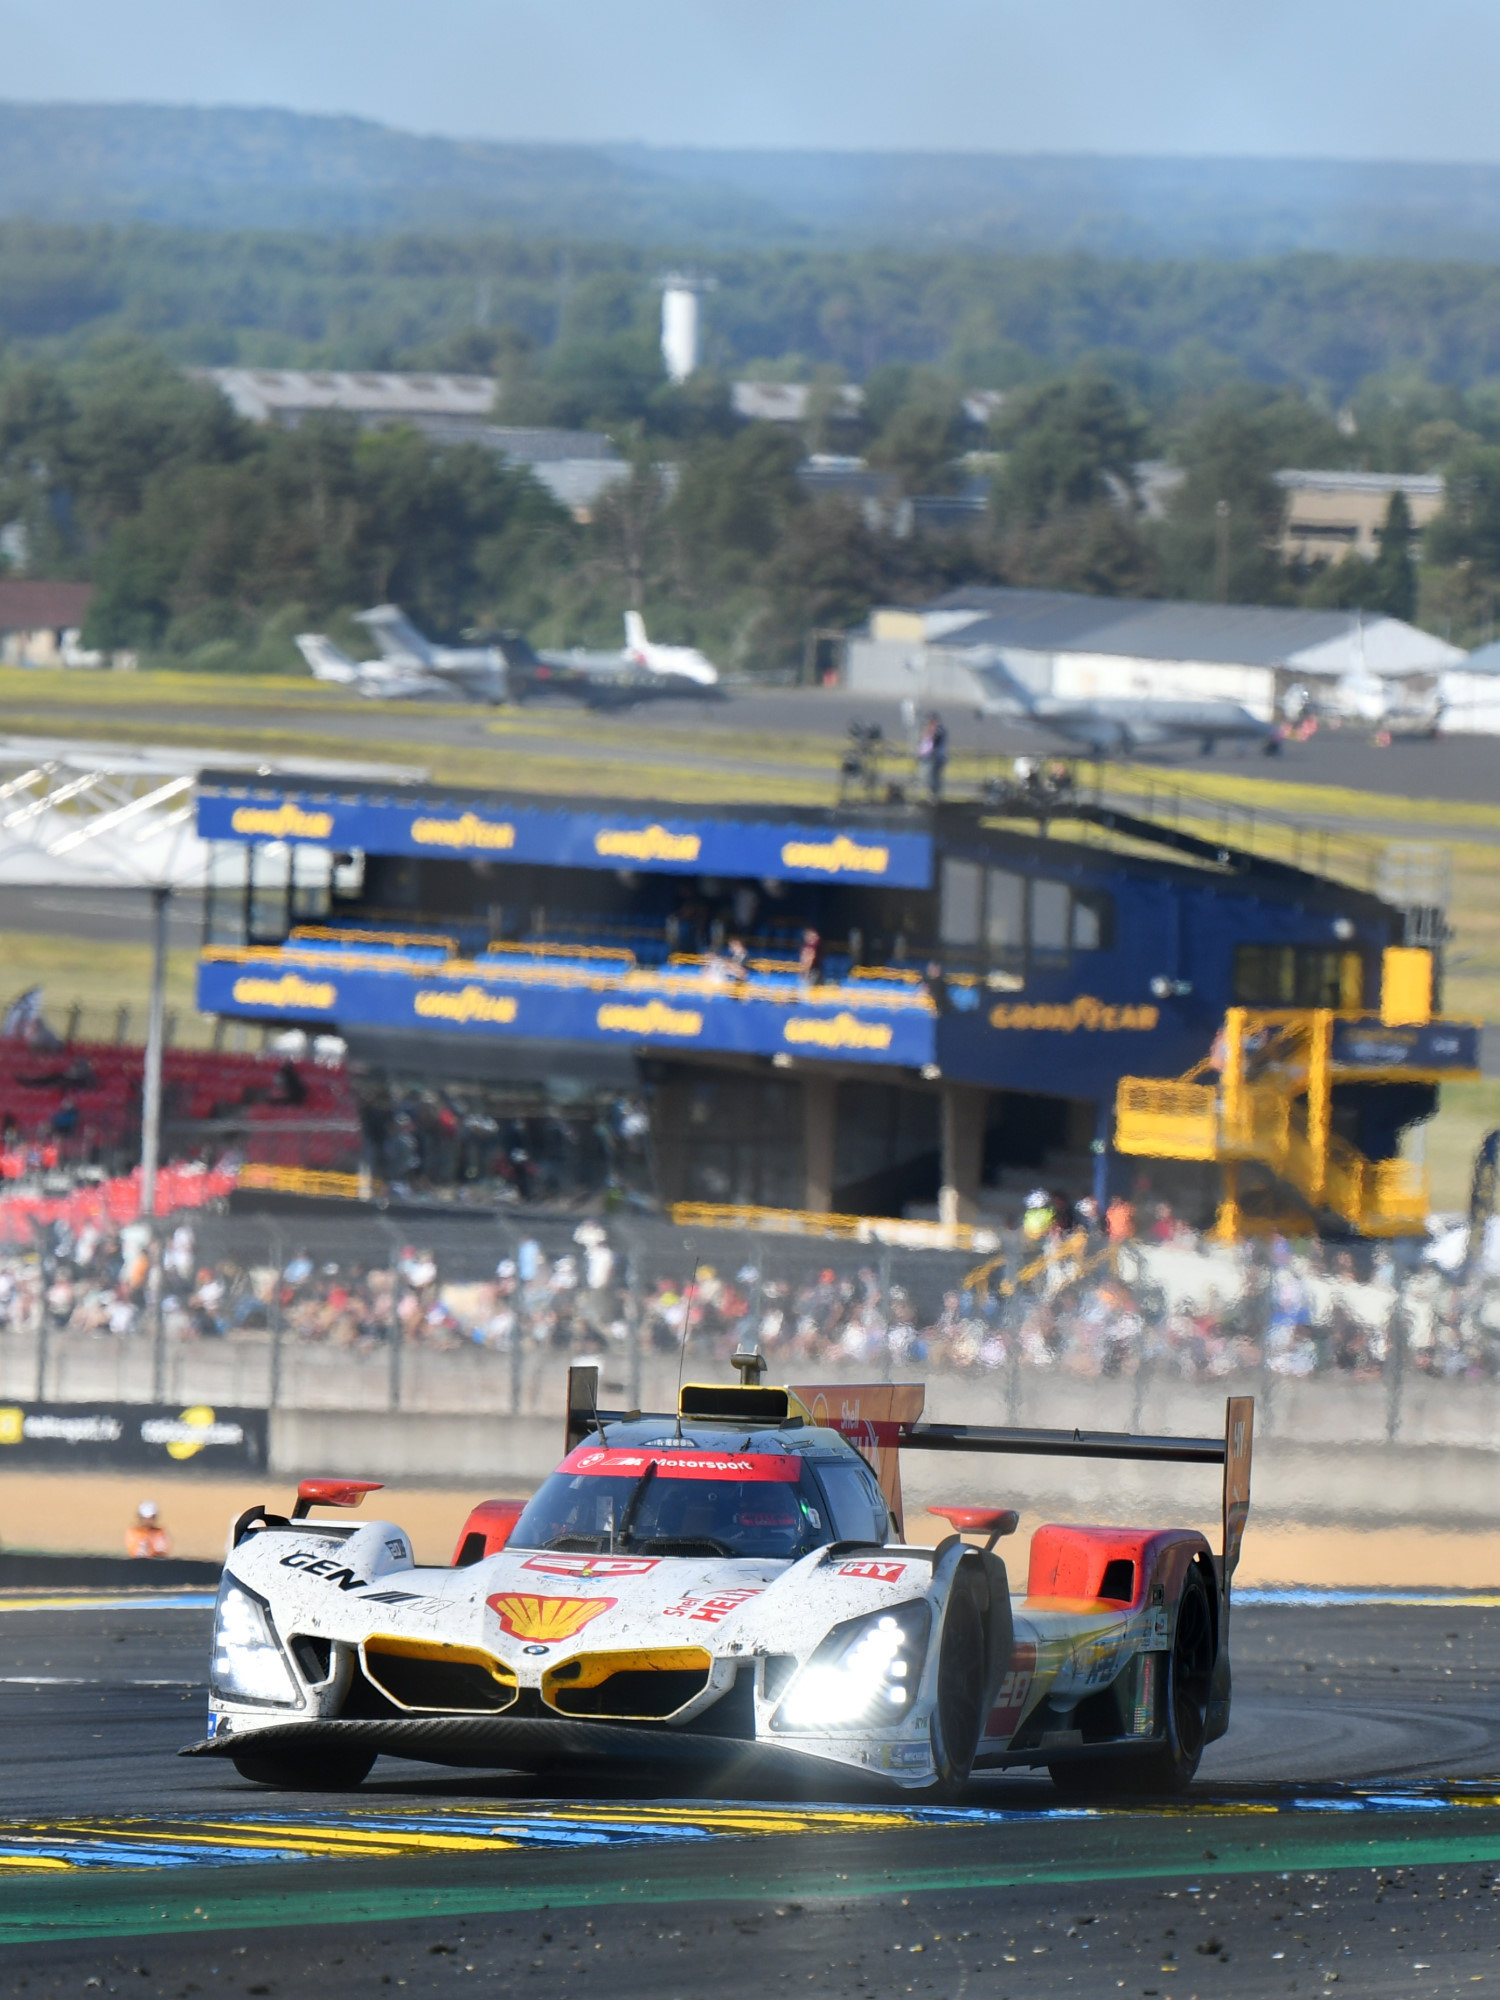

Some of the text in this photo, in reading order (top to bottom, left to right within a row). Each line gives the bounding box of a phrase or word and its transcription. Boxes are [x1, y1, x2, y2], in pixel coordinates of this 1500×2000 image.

[840, 1399, 860, 1429] Shell
[650, 1457, 753, 1470] Motorsport
[279, 1551, 369, 1592] GEN
[529, 1557, 653, 1571] 20
[843, 1562, 899, 1578] HY
[687, 1588, 767, 1623] HELIX
